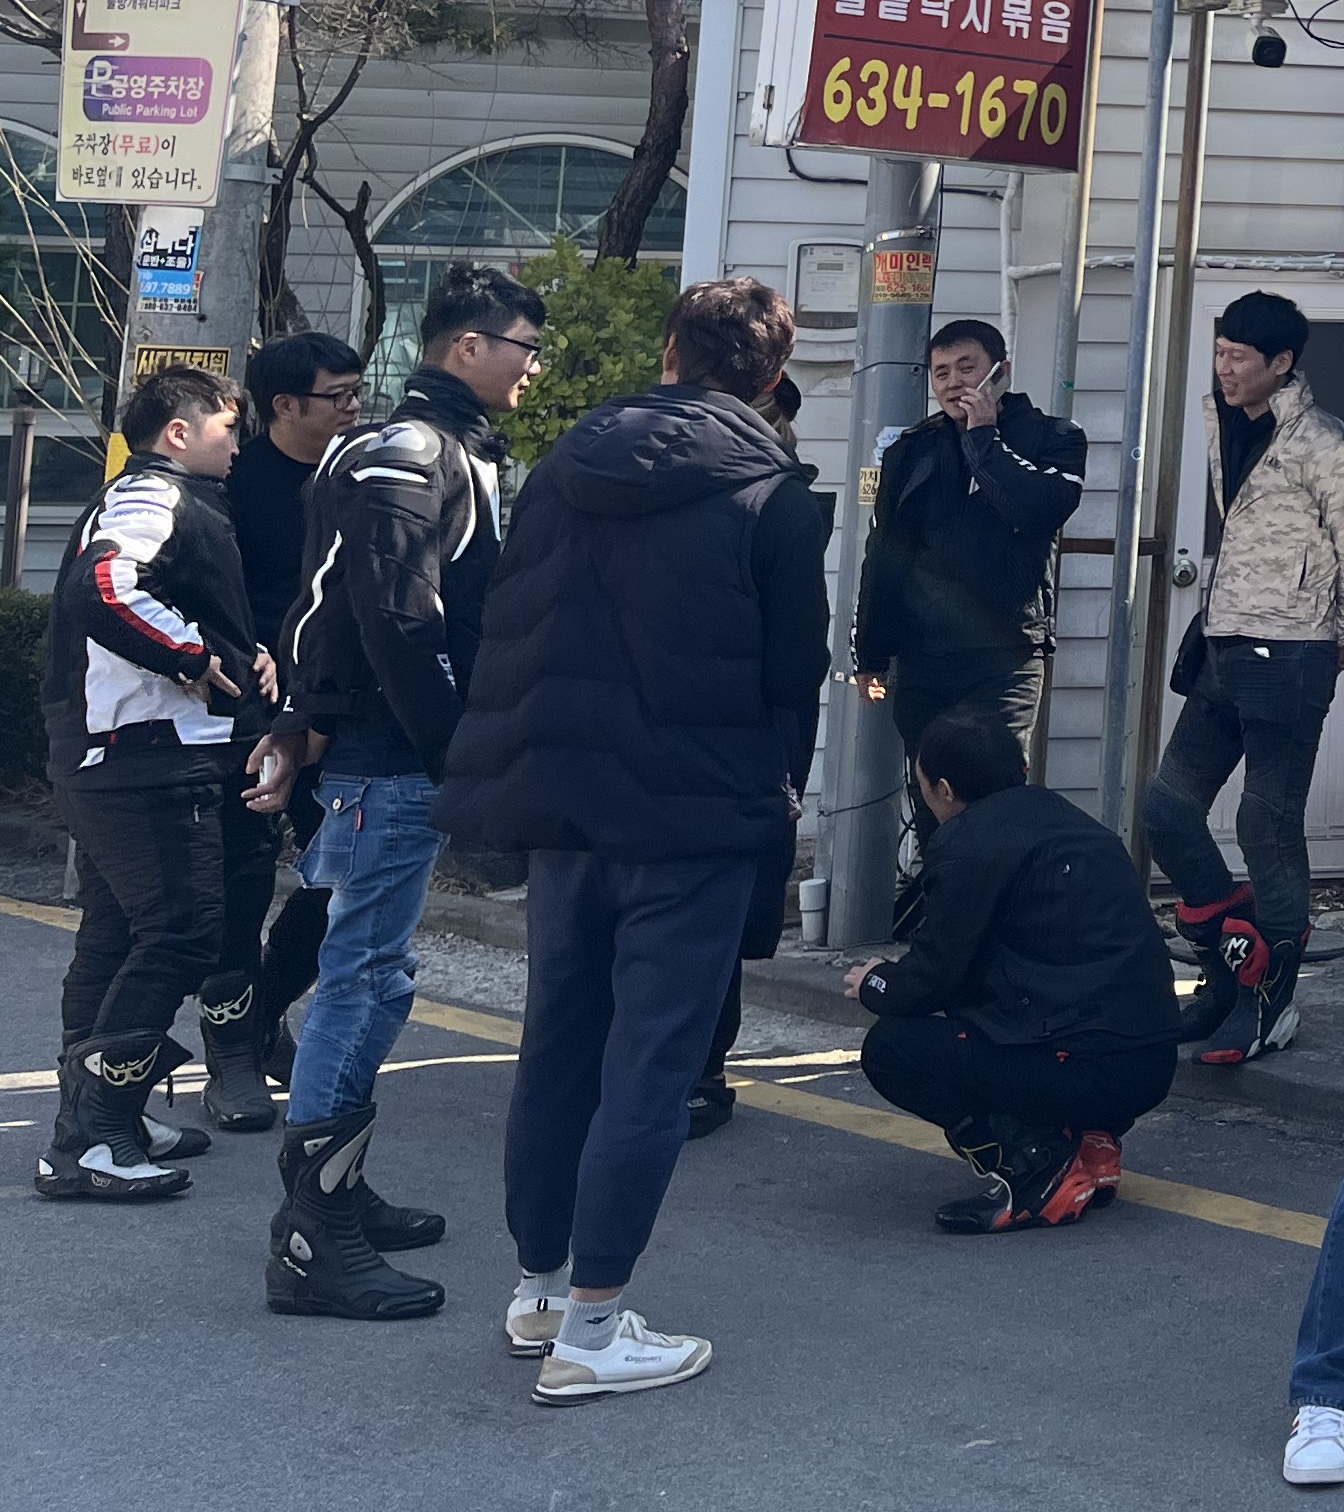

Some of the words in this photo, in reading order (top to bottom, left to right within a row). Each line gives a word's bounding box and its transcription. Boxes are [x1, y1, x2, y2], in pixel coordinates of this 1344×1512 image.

[111, 74, 205, 100] 공영주차장
[101, 102, 133, 116] Public
[136, 104, 177, 119] Parking
[180, 105, 198, 118] Lot
[822, 56, 1068, 146] 634-1670
[131, 167, 202, 191] 있습니다.
